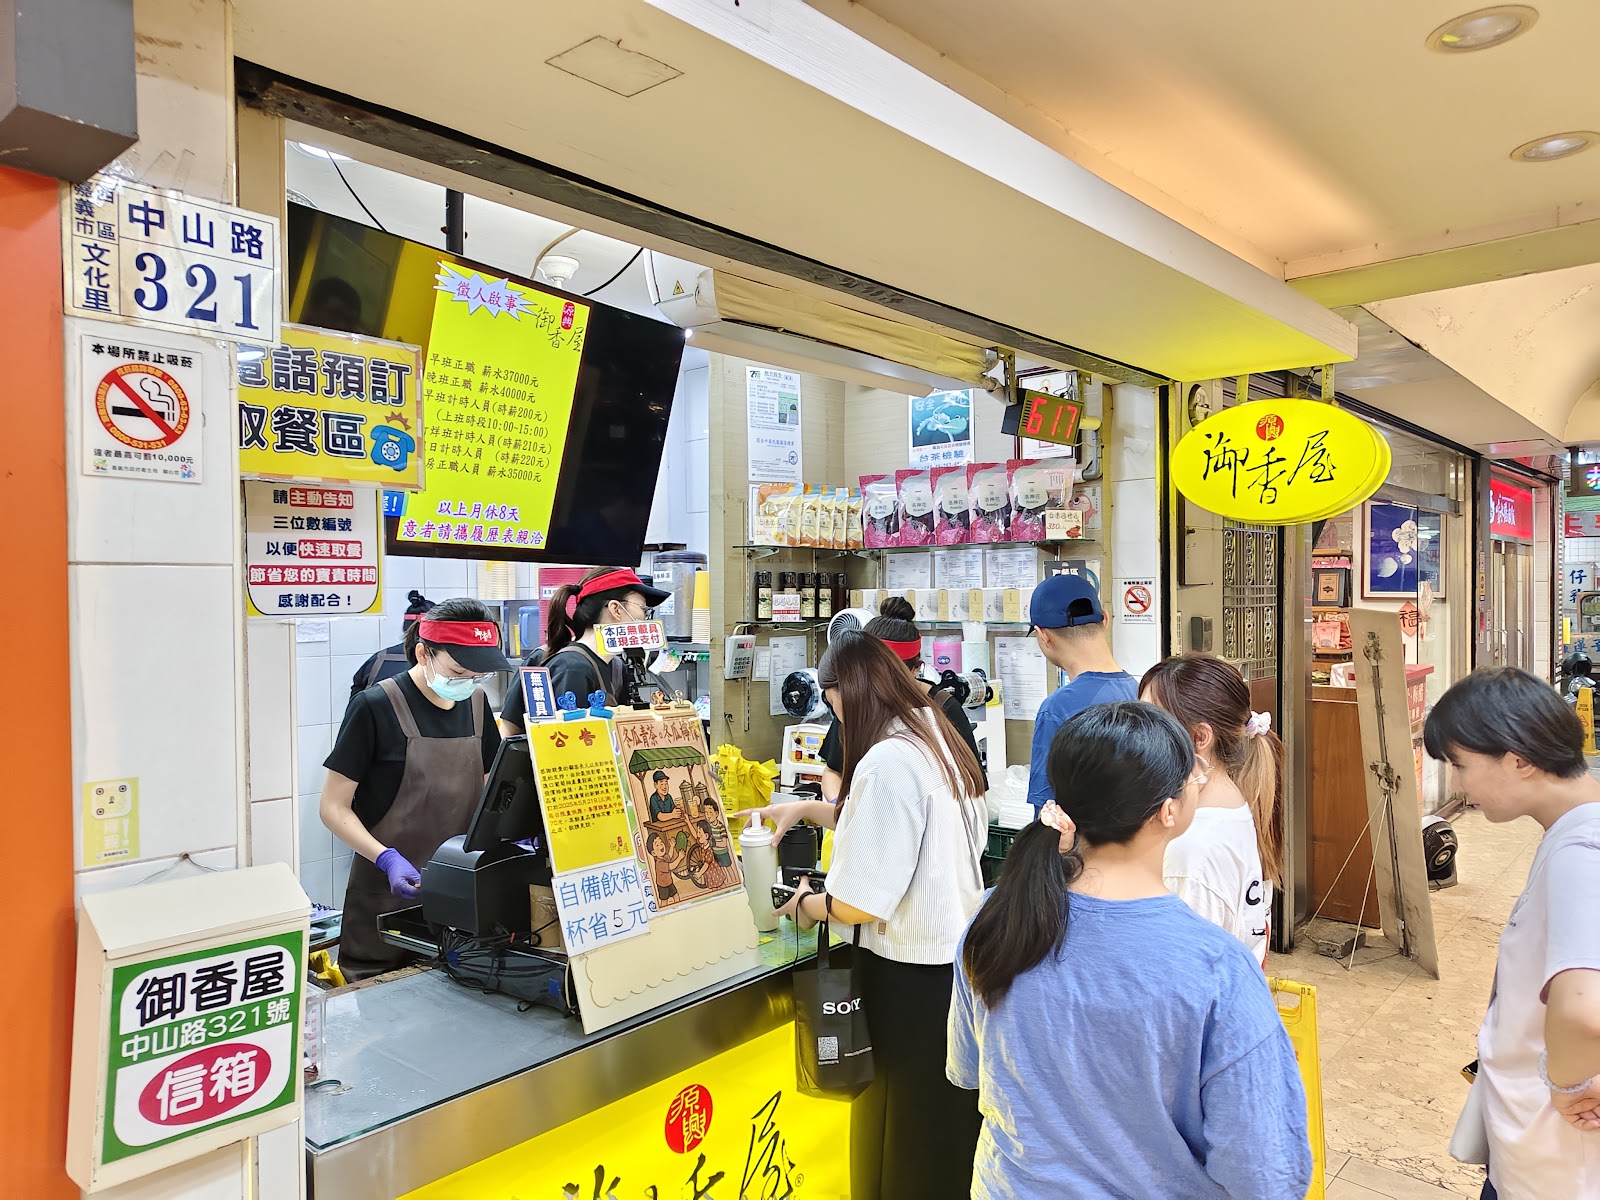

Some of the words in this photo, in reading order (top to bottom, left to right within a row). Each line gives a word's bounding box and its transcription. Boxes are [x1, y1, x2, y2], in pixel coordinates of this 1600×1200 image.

[128, 200, 264, 260] 中山路
[81, 243, 112, 312] 文化里
[134, 252, 260, 331] 321
[536, 307, 585, 352] 御香屋
[92, 343, 193, 368] 本場所禁止吸菸
[430, 353, 476, 374] 早班正職
[481, 365, 539, 388] 薪水37000元
[426, 371, 473, 391] 晚班正職
[478, 382, 536, 404] 薪水40000元
[1026, 397, 1078, 439] 617
[424, 441, 483, 460] 日計時人員
[1202, 430, 1337, 504] 御香屋
[487, 465, 542, 483] 薪水35000元
[273, 489, 353, 508] 請主動告知
[437, 500, 520, 522] 以上月休8天
[273, 516, 352, 531] 三位數編號
[266, 541, 362, 558] 以便快速取餐
[250, 567, 376, 583] 節省您的寶貴時間
[604, 624, 658, 637] 本店無載具
[606, 634, 660, 648] 僅現金支付
[530, 672, 548, 716] 無載具
[549, 727, 596, 748] 公告
[558, 864, 641, 910] 自備飲料
[565, 901, 648, 947] 杯省5元
[136, 951, 285, 1027] 御香屋
[822, 998, 862, 1015] SOY
[121, 996, 291, 1062] 中山路321號
[156, 1049, 260, 1121] 信箱
